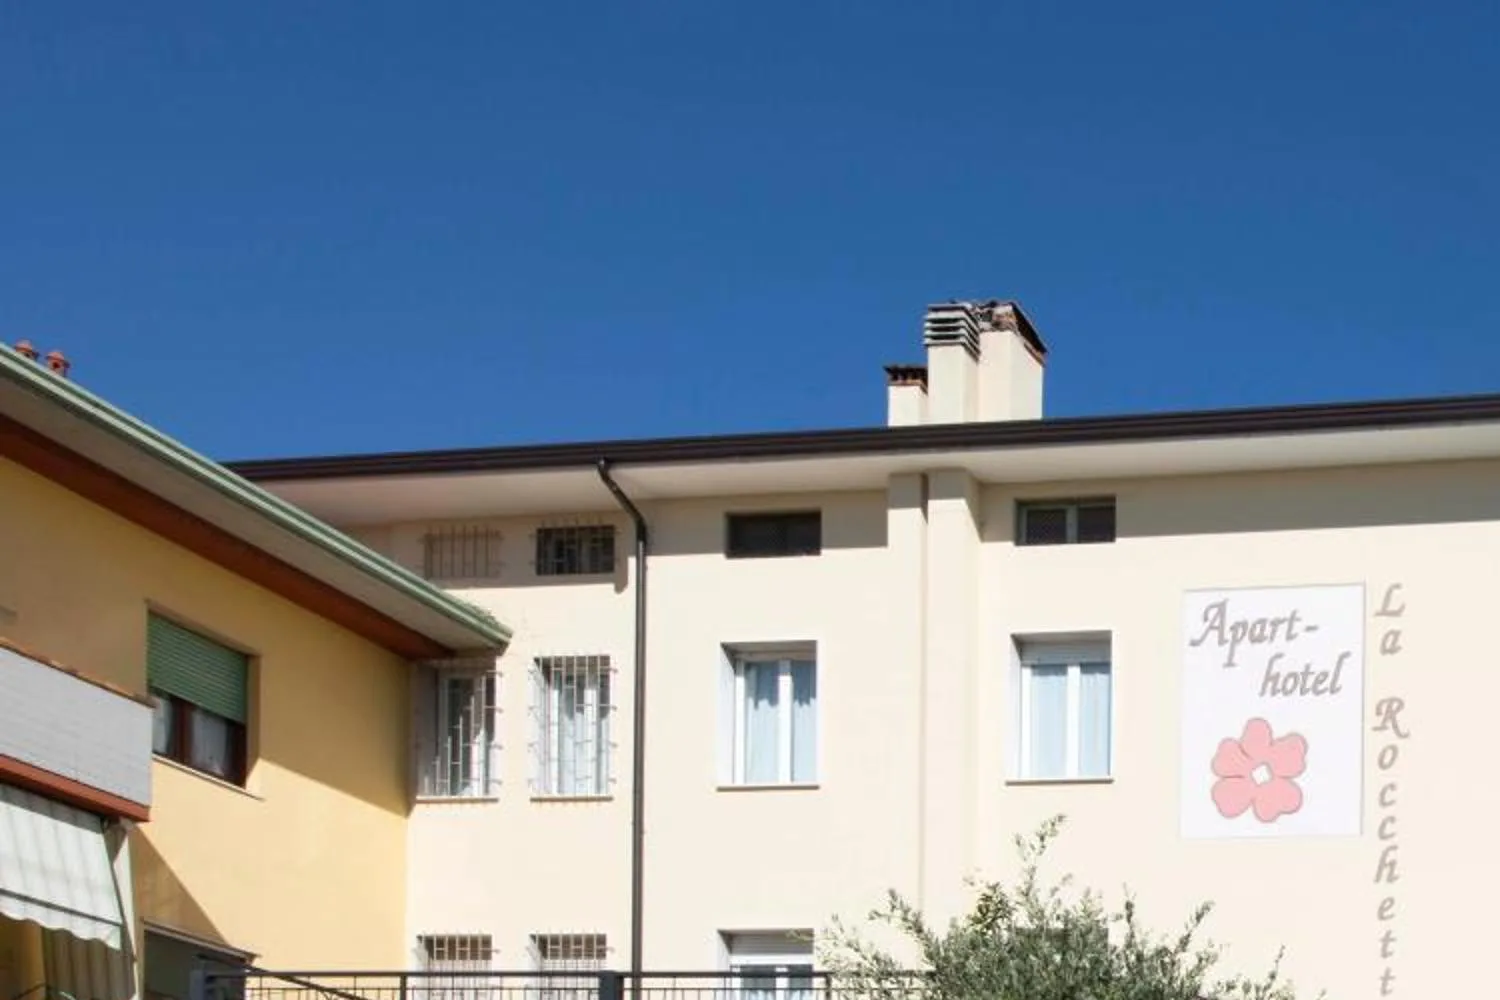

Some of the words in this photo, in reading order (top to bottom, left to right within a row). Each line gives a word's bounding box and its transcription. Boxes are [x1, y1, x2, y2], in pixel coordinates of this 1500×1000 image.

[1188, 598, 1319, 669] Apart-
[1373, 583, 1406, 656] La
[1258, 651, 1352, 698] hotel
